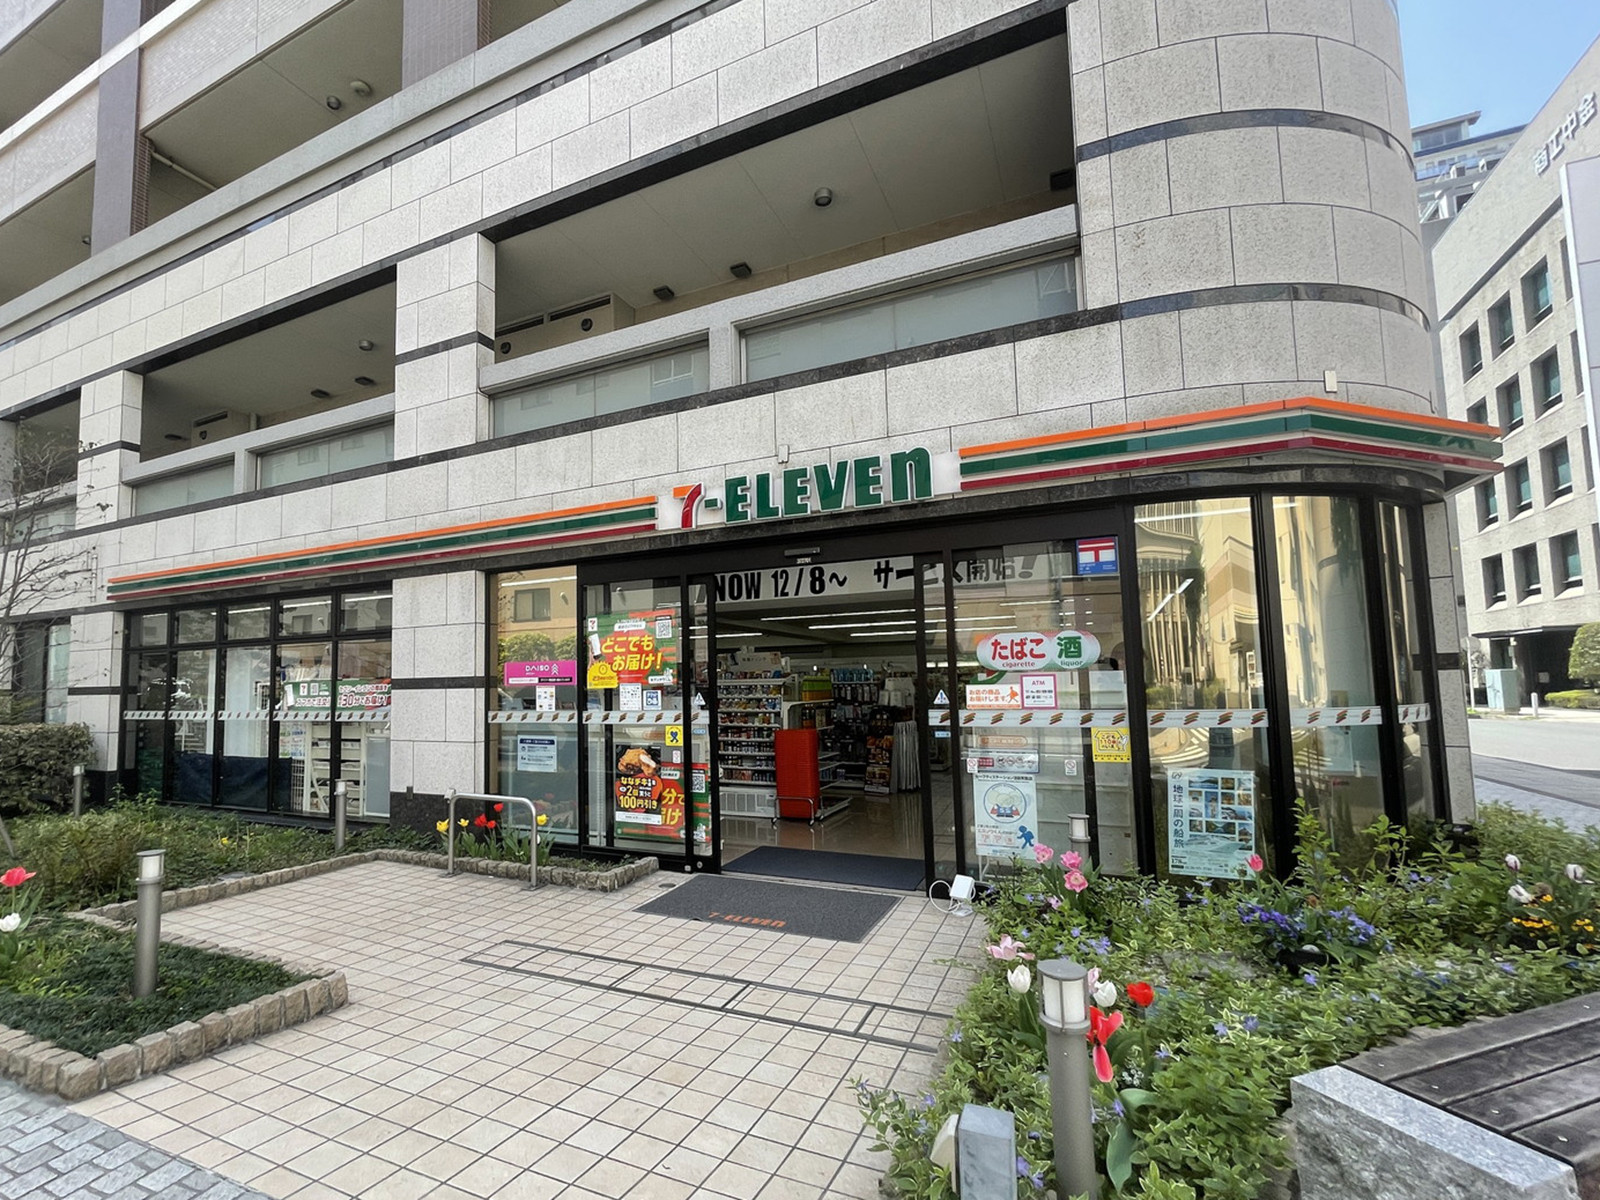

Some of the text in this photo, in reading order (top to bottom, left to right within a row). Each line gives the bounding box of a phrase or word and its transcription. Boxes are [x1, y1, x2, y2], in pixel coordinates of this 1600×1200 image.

[672, 447, 933, 529] 7-ELEVEn
[601, 635, 654, 653] どこでも
[991, 635, 1082, 660] たばこ 酒
[612, 652, 662, 671] お届け!
[620, 796, 657, 809] 100円引き
[1173, 785, 1184, 848] 地球一周の船旅
